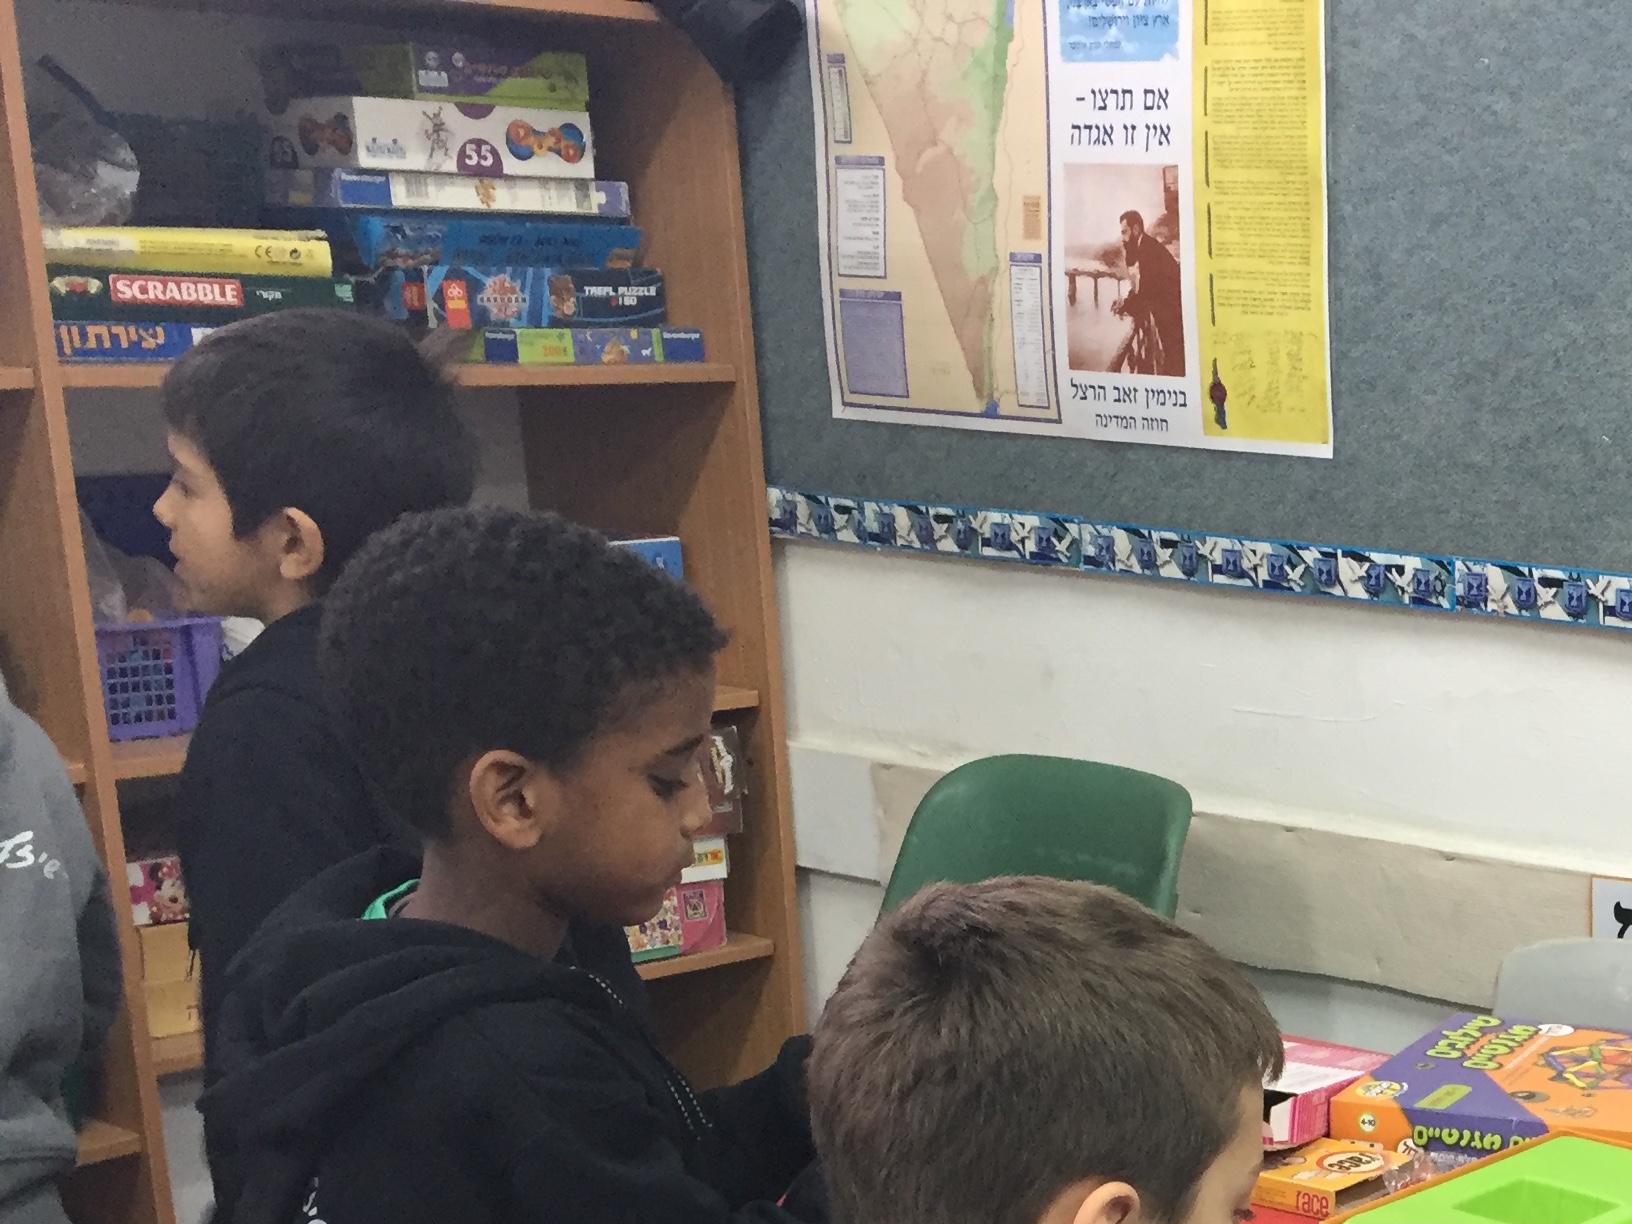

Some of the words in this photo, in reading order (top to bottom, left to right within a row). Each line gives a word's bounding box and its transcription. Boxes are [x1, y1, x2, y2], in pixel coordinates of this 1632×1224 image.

[1090, 87, 1134, 112] תרצו
[1142, 87, 1169, 112] אם
[1070, 123, 1114, 146] אגדה
[1122, 123, 1137, 146] זו
[1144, 123, 1172, 154] אין
[464, 143, 494, 167] 55
[115, 278, 238, 304] SCRABBLE
[583, 286, 616, 297] TREFL
[618, 286, 657, 297] PUZZLE
[1070, 377, 1107, 402] הרצל
[1112, 384, 1139, 405] זאב
[1143, 386, 1188, 410] בנימין
[1094, 412, 1137, 431] המדינה
[1141, 415, 1169, 433] חוזה
[1296, 1190, 1330, 1218] race
